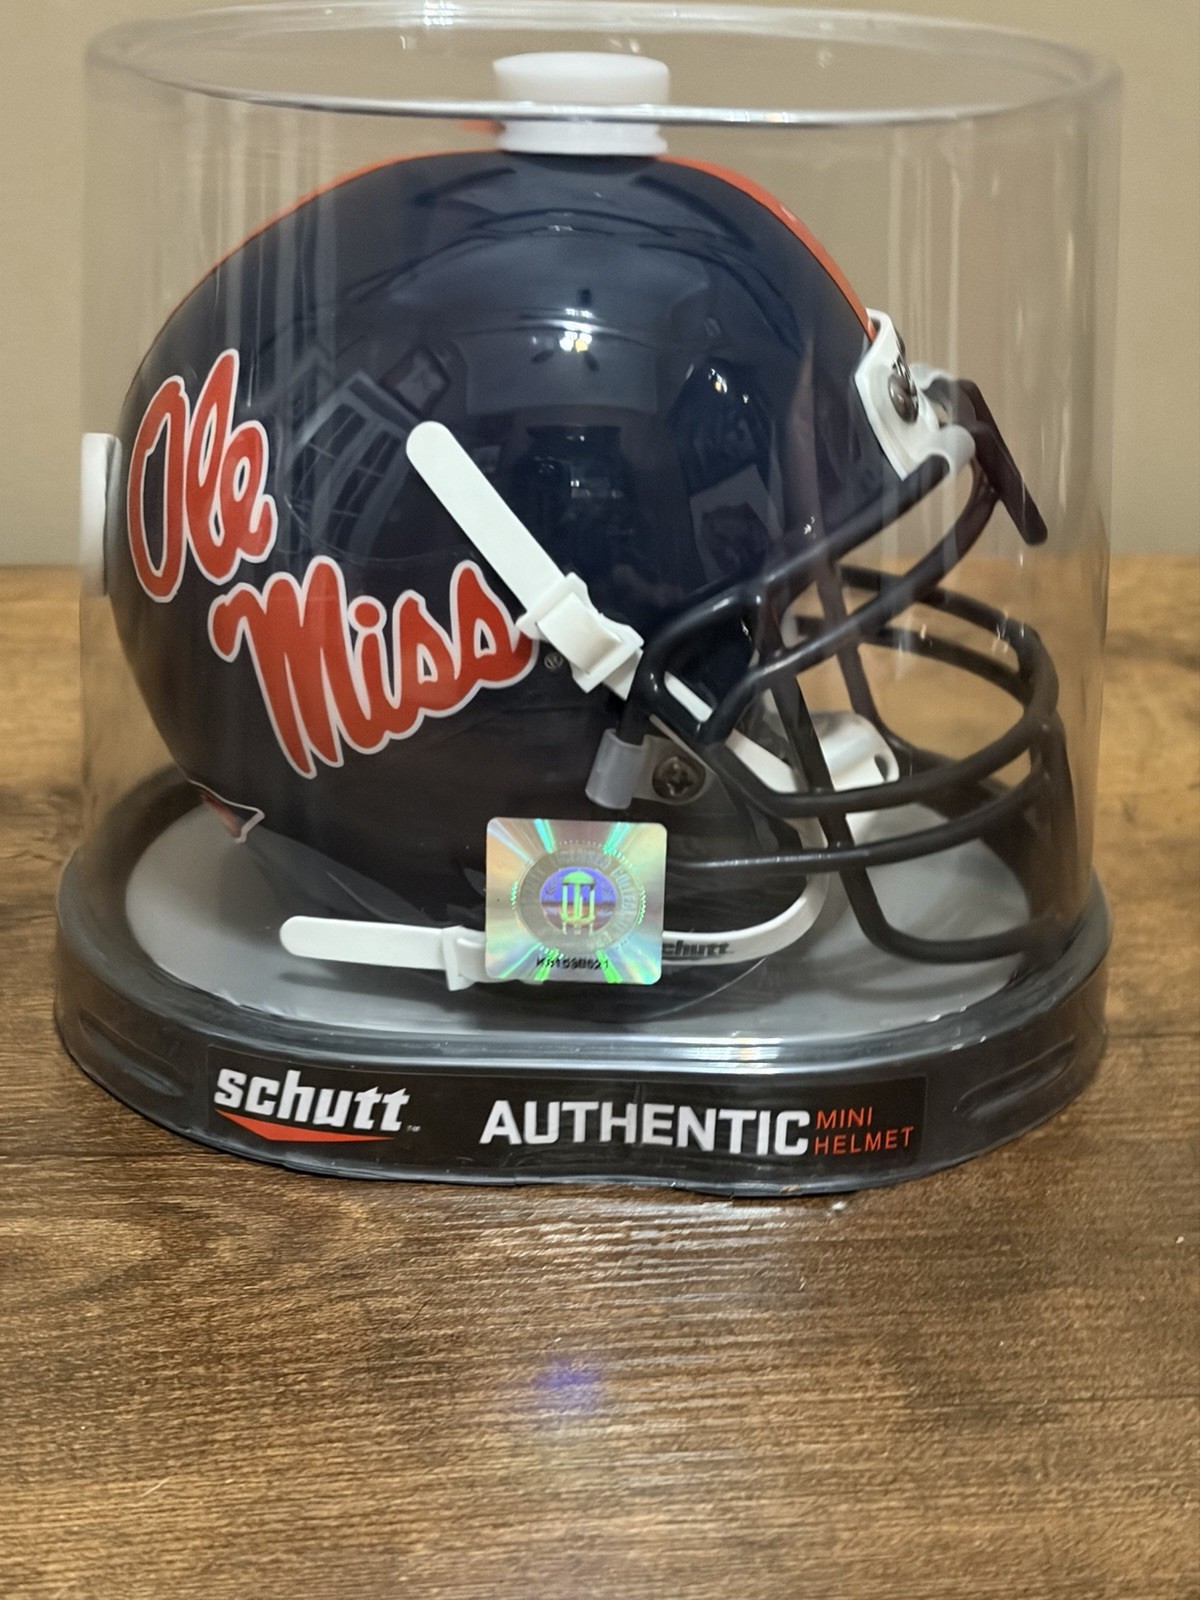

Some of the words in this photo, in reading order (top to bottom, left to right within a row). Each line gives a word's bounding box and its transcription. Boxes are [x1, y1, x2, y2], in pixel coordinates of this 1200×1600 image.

[127, 348, 278, 602] Ole
[208, 555, 539, 778] Miss
[661, 940, 730, 956] chutt
[214, 1068, 411, 1132] schutt
[479, 1100, 811, 1156] AUTHENTIC
[816, 1106, 873, 1130] MINI
[814, 1126, 914, 1155] HELMET
